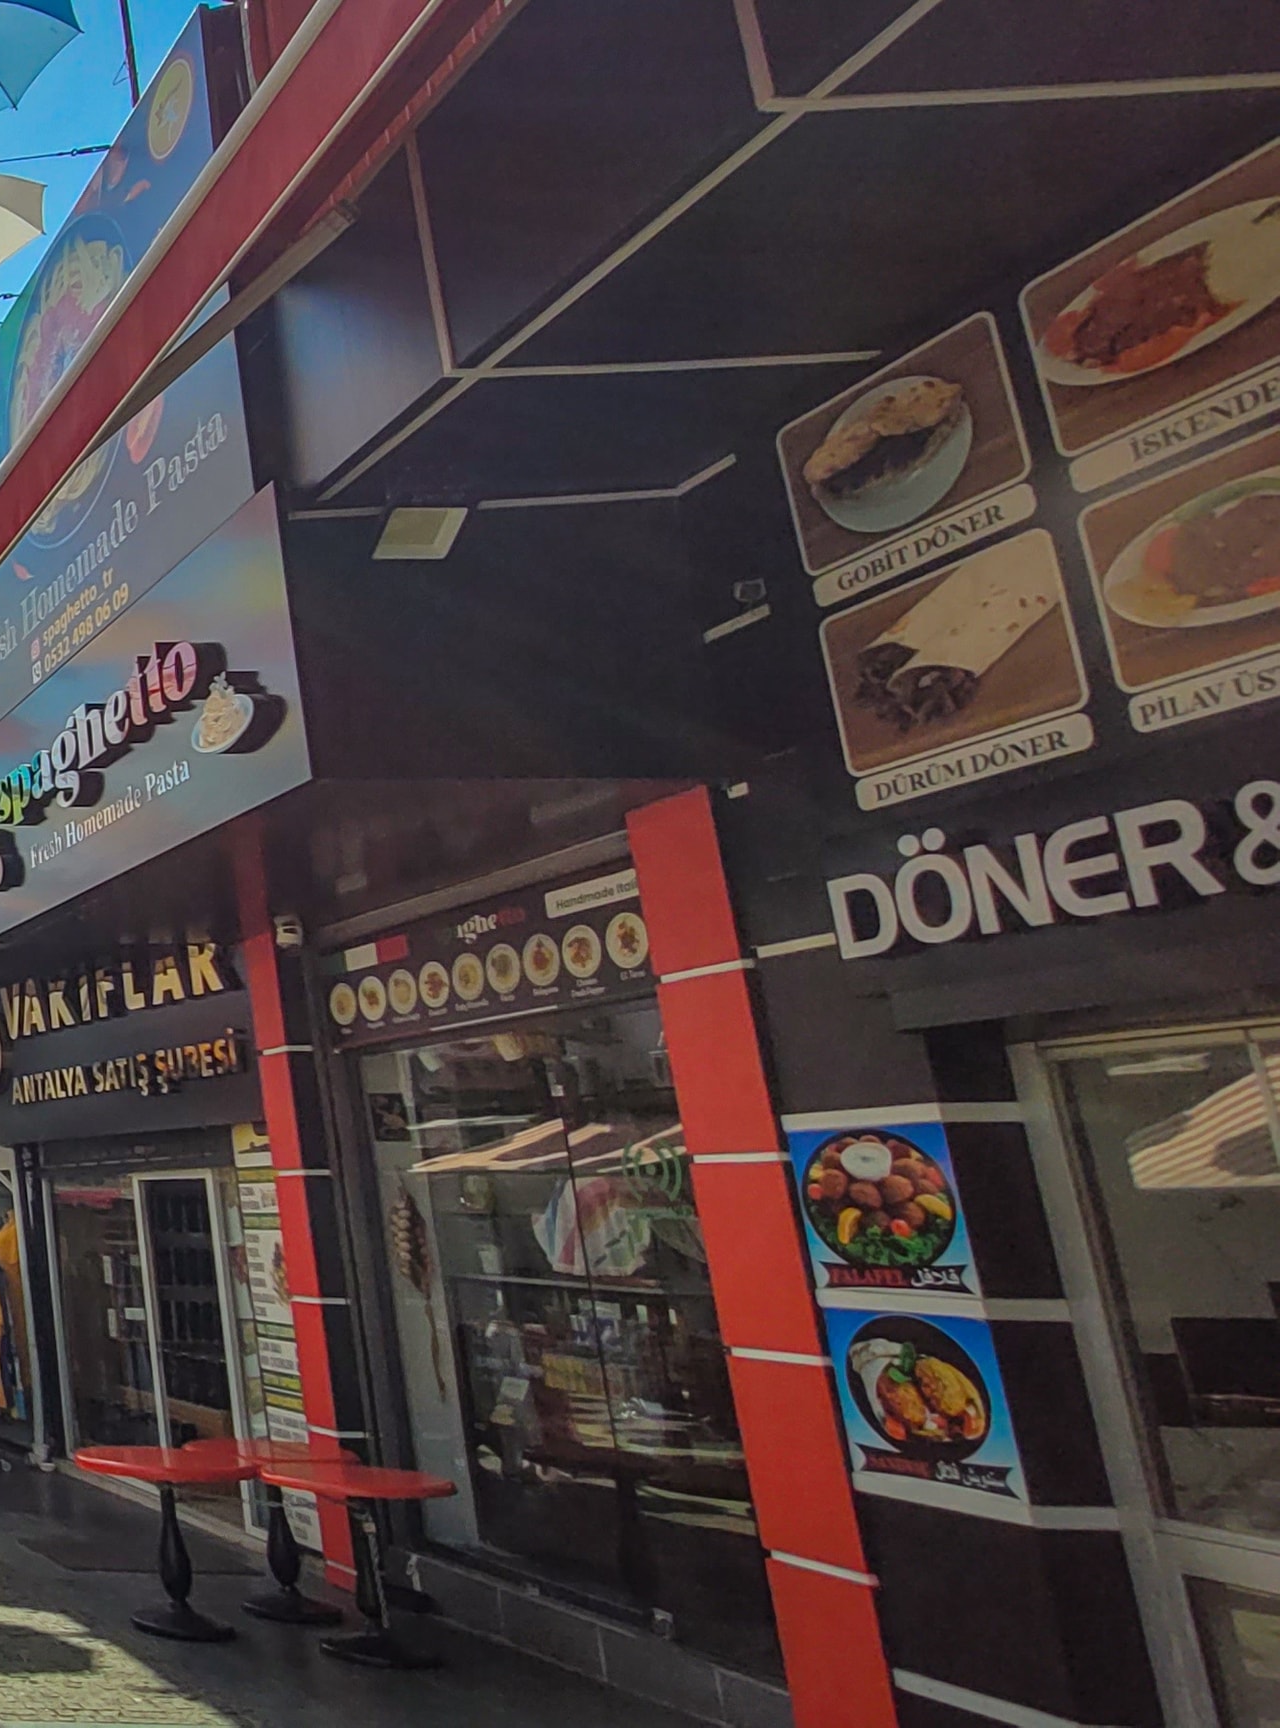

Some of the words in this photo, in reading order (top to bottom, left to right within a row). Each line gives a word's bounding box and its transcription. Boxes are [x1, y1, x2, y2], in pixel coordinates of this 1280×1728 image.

[20, 499, 139, 642] Homemade
[142, 411, 228, 517] Pasta
[914, 504, 1005, 557] DÖNER
[43, 566, 114, 648] spaghetto_tr
[43, 636, 71, 673] 0532
[95, 603, 112, 628] 06
[112, 583, 130, 611] 09
[874, 760, 967, 802] DÜRÜM
[970, 730, 1070, 774] DÖNER
[30, 833, 62, 869] Fresh
[65, 785, 142, 849] Homemade
[145, 758, 191, 802] Pasta
[826, 799, 1227, 960] DÖNER
[11, 1065, 88, 1106] ANTALYA
[92, 1053, 150, 1097] SATIŞ
